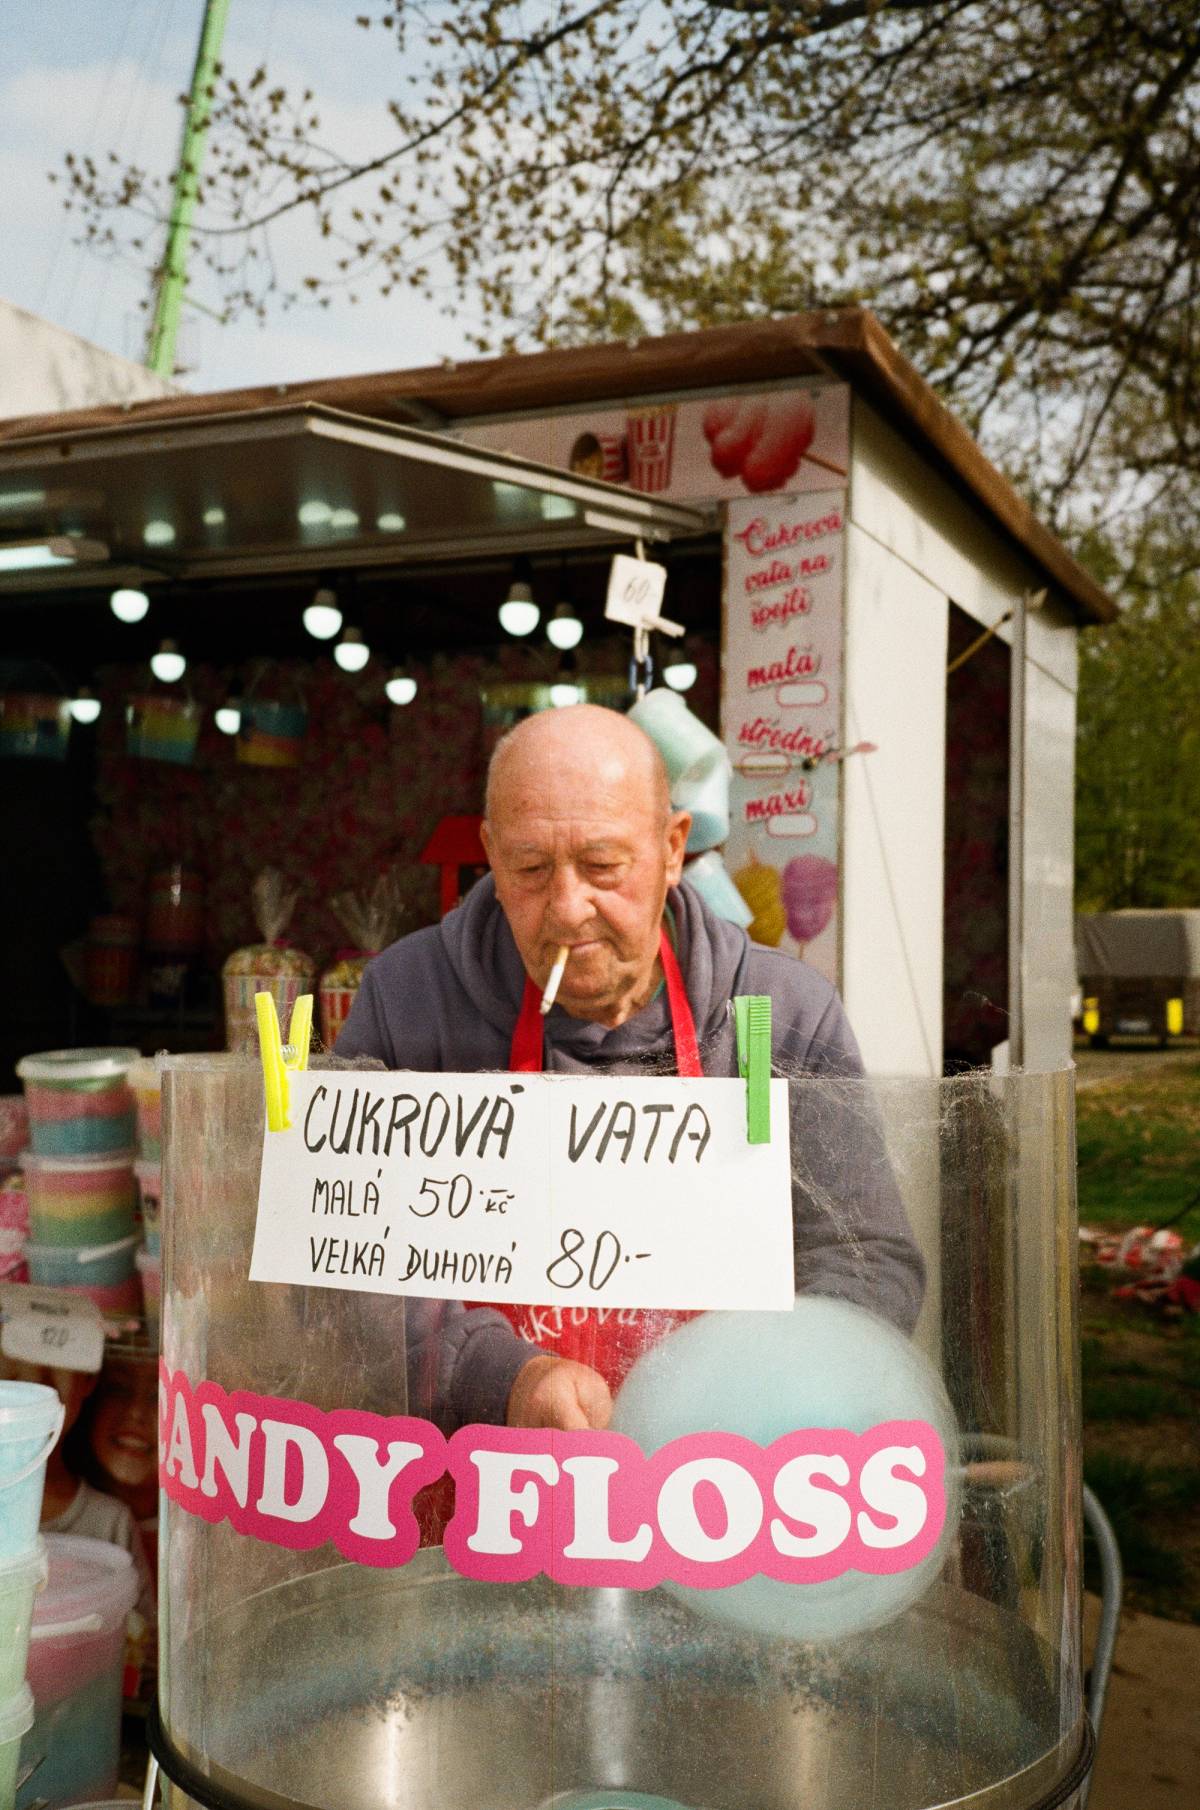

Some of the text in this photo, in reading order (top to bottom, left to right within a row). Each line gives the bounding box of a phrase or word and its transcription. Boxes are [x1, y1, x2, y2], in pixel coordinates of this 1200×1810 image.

[799, 554, 829, 575] na
[745, 778, 807, 820] maxi
[303, 1084, 711, 1164] CUKROVÁ VATA
[311, 1168, 383, 1217] MALÁ
[310, 1225, 391, 1277] VELKÁ
[398, 1241, 517, 1284] DUHOVÁ
[467, 1445, 928, 1562] FLOSS
